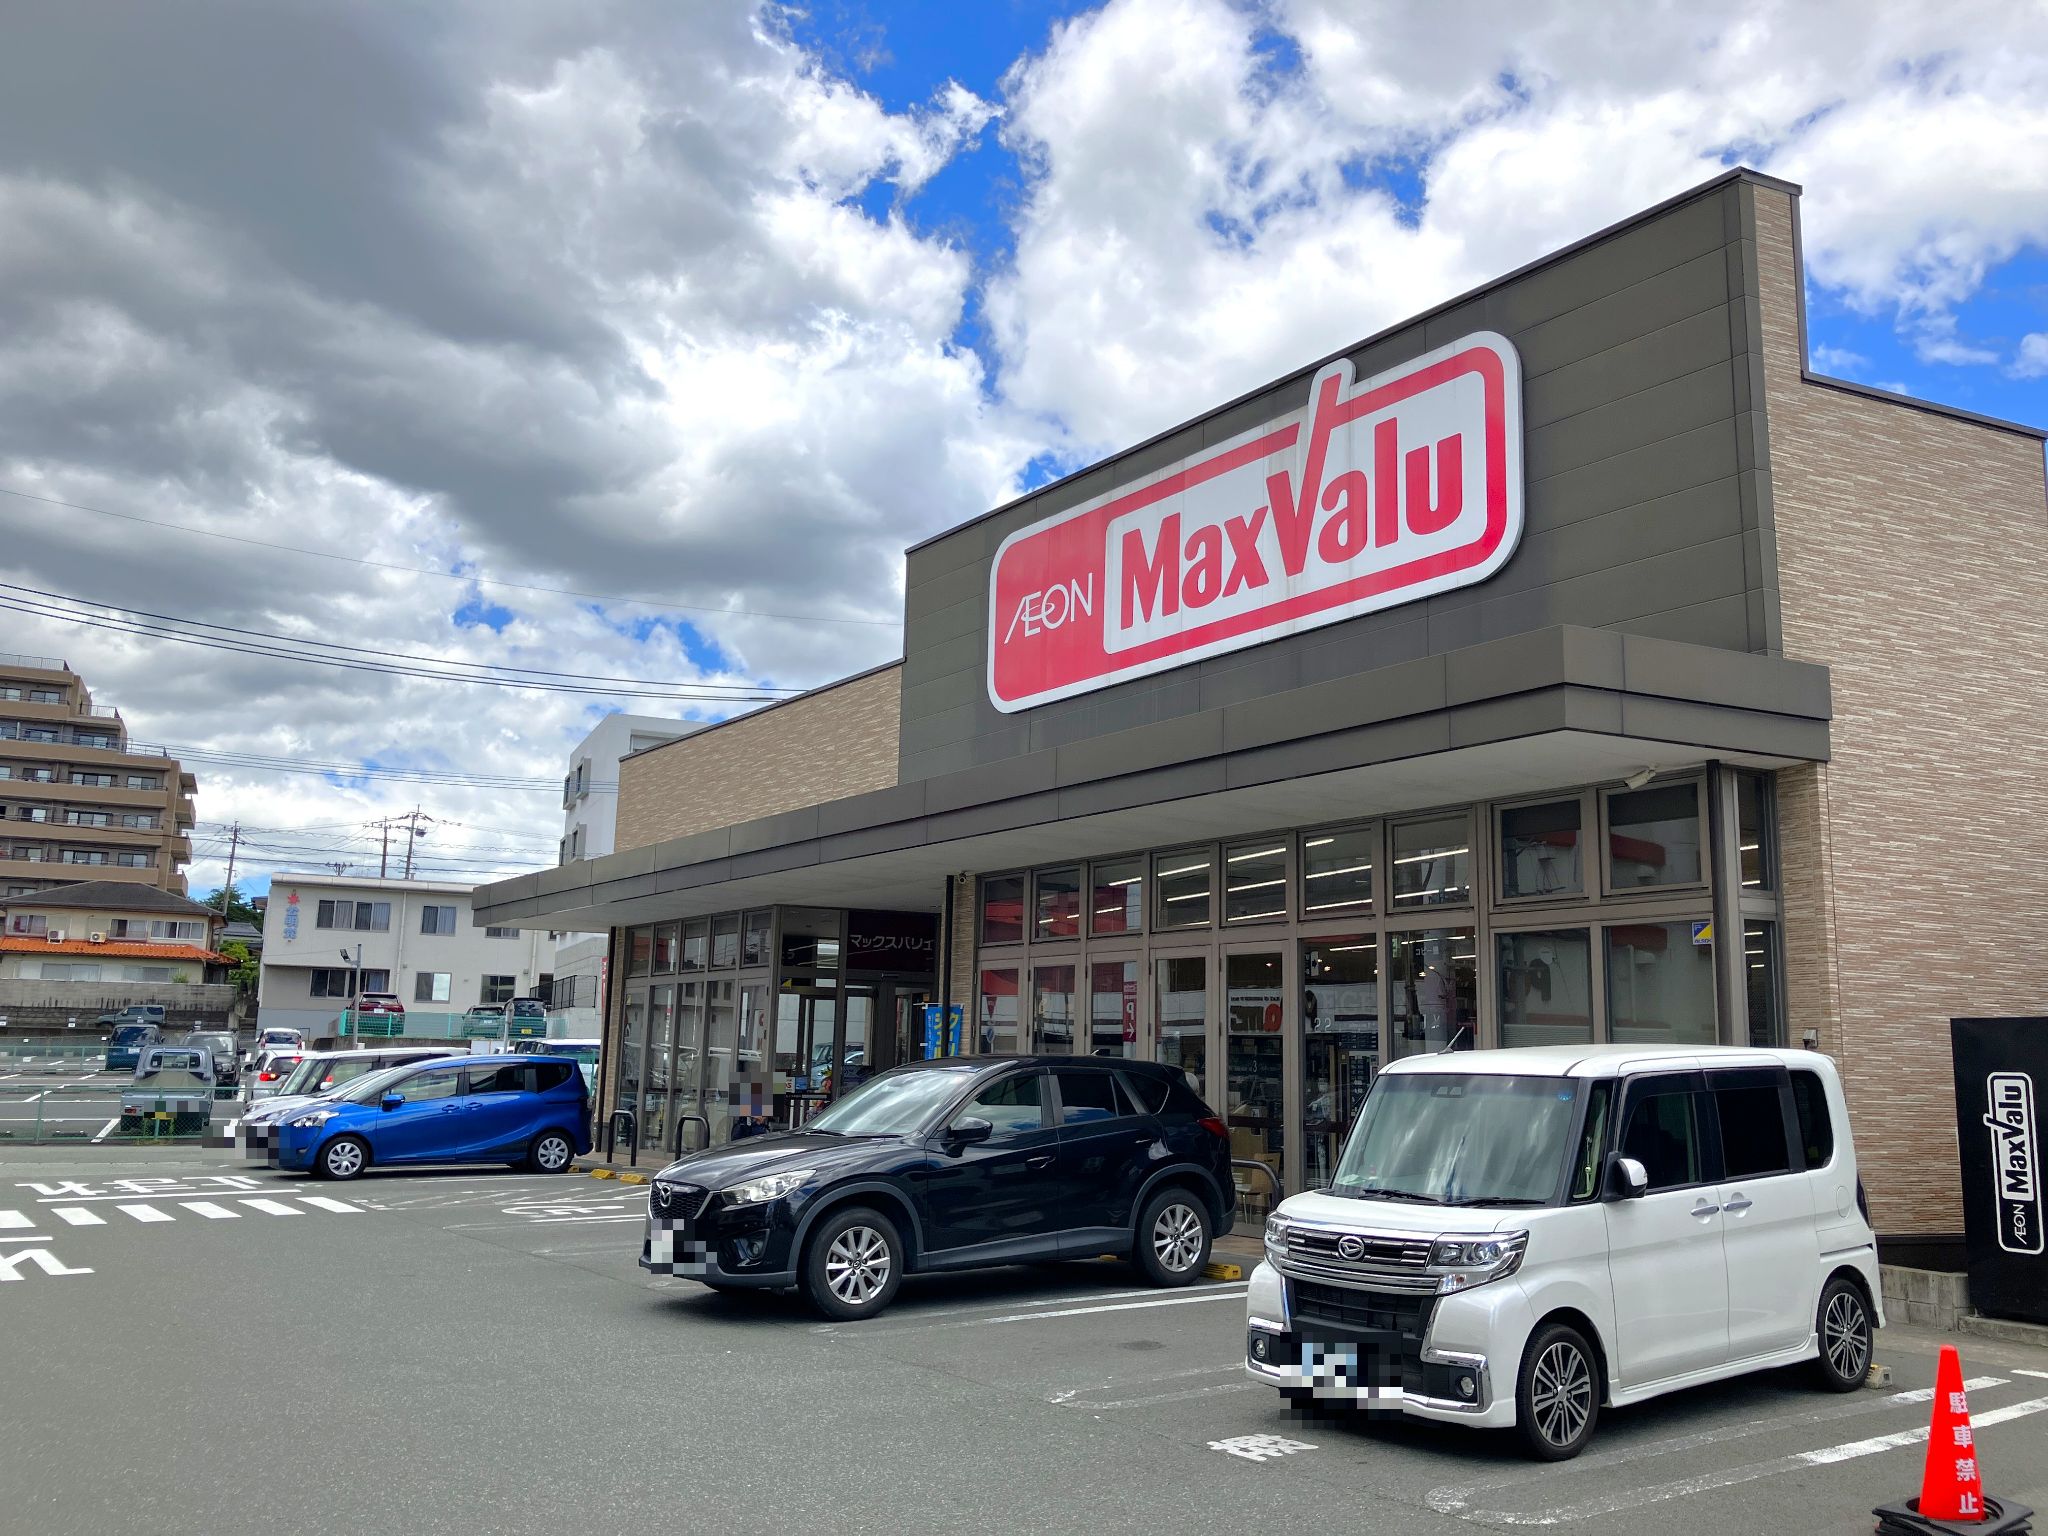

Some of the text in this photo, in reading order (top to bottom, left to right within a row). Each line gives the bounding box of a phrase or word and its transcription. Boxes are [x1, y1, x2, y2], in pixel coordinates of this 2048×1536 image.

[1120, 373, 1463, 631] MaxValu
[1986, 1085, 2029, 1194] MaxValu
[1948, 1391, 1979, 1514] 駐車禁止
